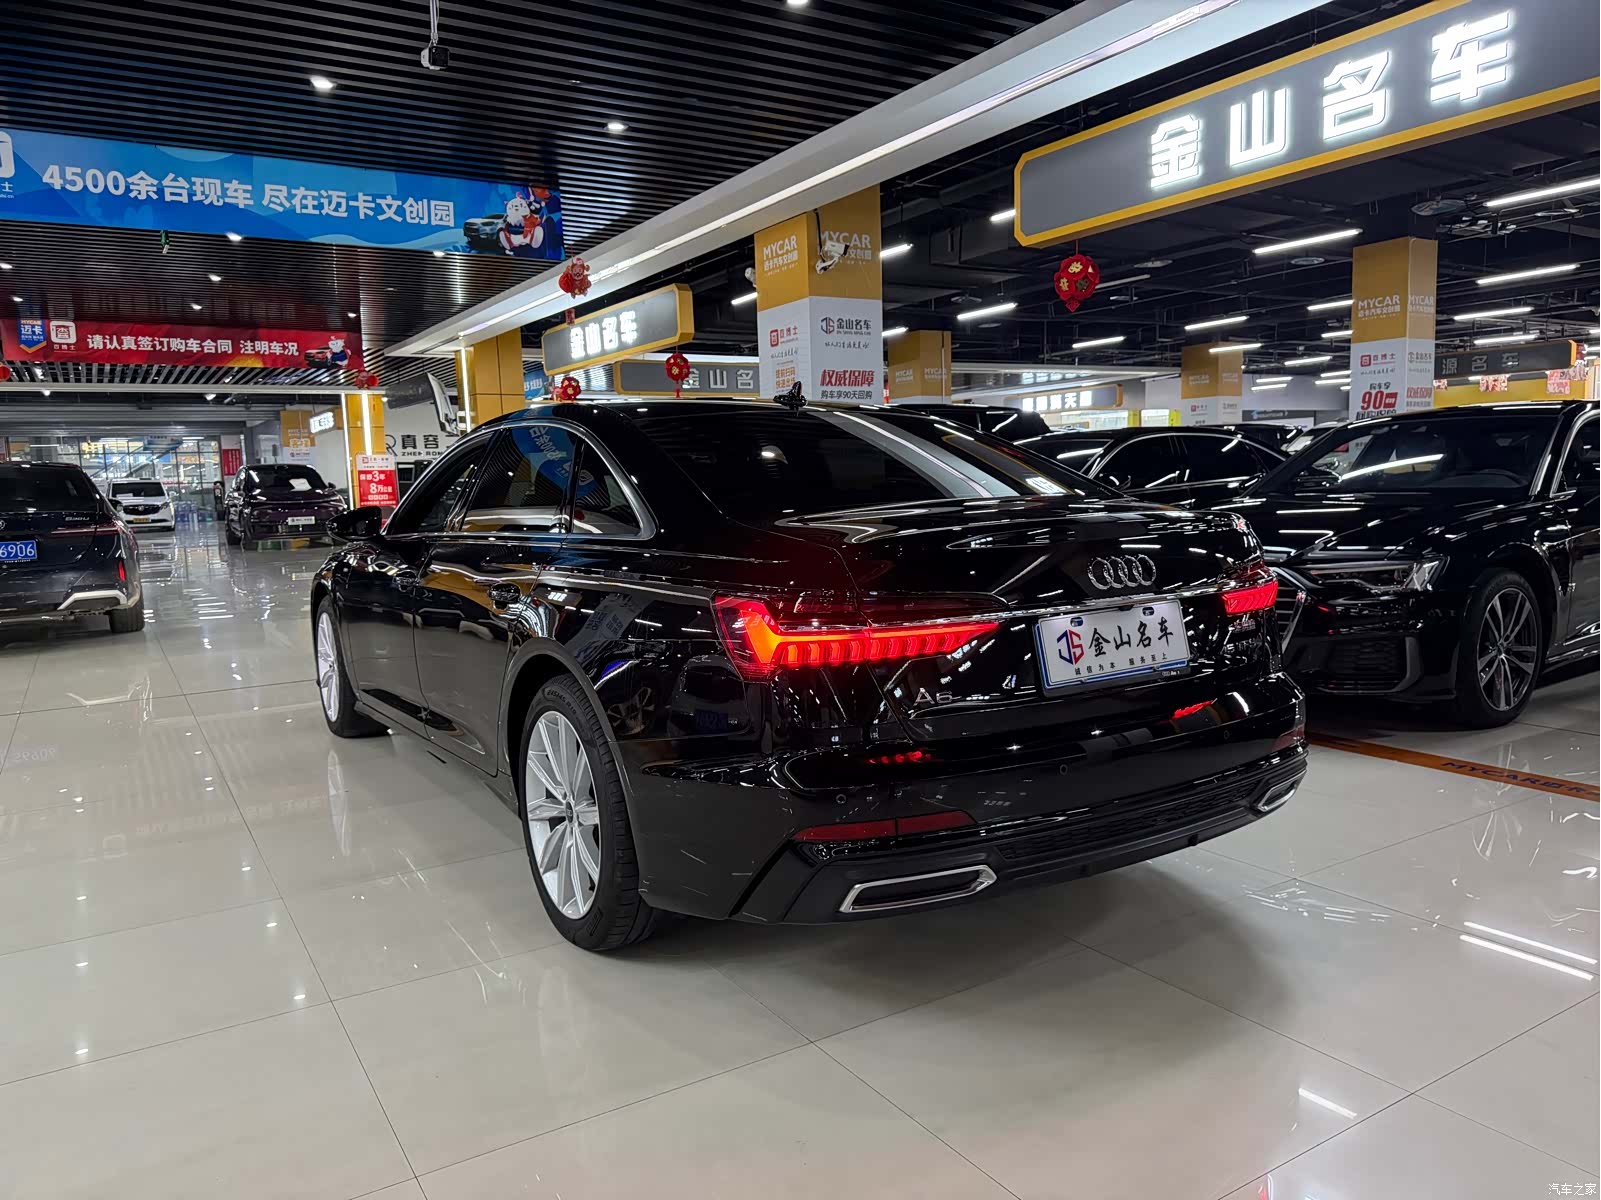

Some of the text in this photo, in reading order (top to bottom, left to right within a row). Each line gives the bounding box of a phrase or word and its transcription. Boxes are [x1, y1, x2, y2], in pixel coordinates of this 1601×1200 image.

[1150, 10, 1514, 190] 金山名车
[42, 164, 455, 227] 4500余台现车 尽在迈卡文创园
[763, 235, 798, 260] MYCAR
[820, 230, 871, 249] MYCAR
[1358, 294, 1400, 310] MYCAR
[1408, 295, 1434, 305] MYCAR
[20, 325, 43, 335] 迈卡
[570, 310, 639, 359] 金山名车
[836, 317, 872, 331] 金山名车
[87, 334, 299, 356] 请认真签订购车合同 注明车况
[820, 369, 875, 387] 权威保障
[820, 389, 873, 400] 购车享90天回购
[1361, 390, 1384, 411] 90
[0, 543, 35, 558] 6906
[1088, 616, 1174, 658] 金山名车
[1074, 652, 1168, 676] 诚信为本 服务至上
[1440, 761, 1540, 785] MYCAR
